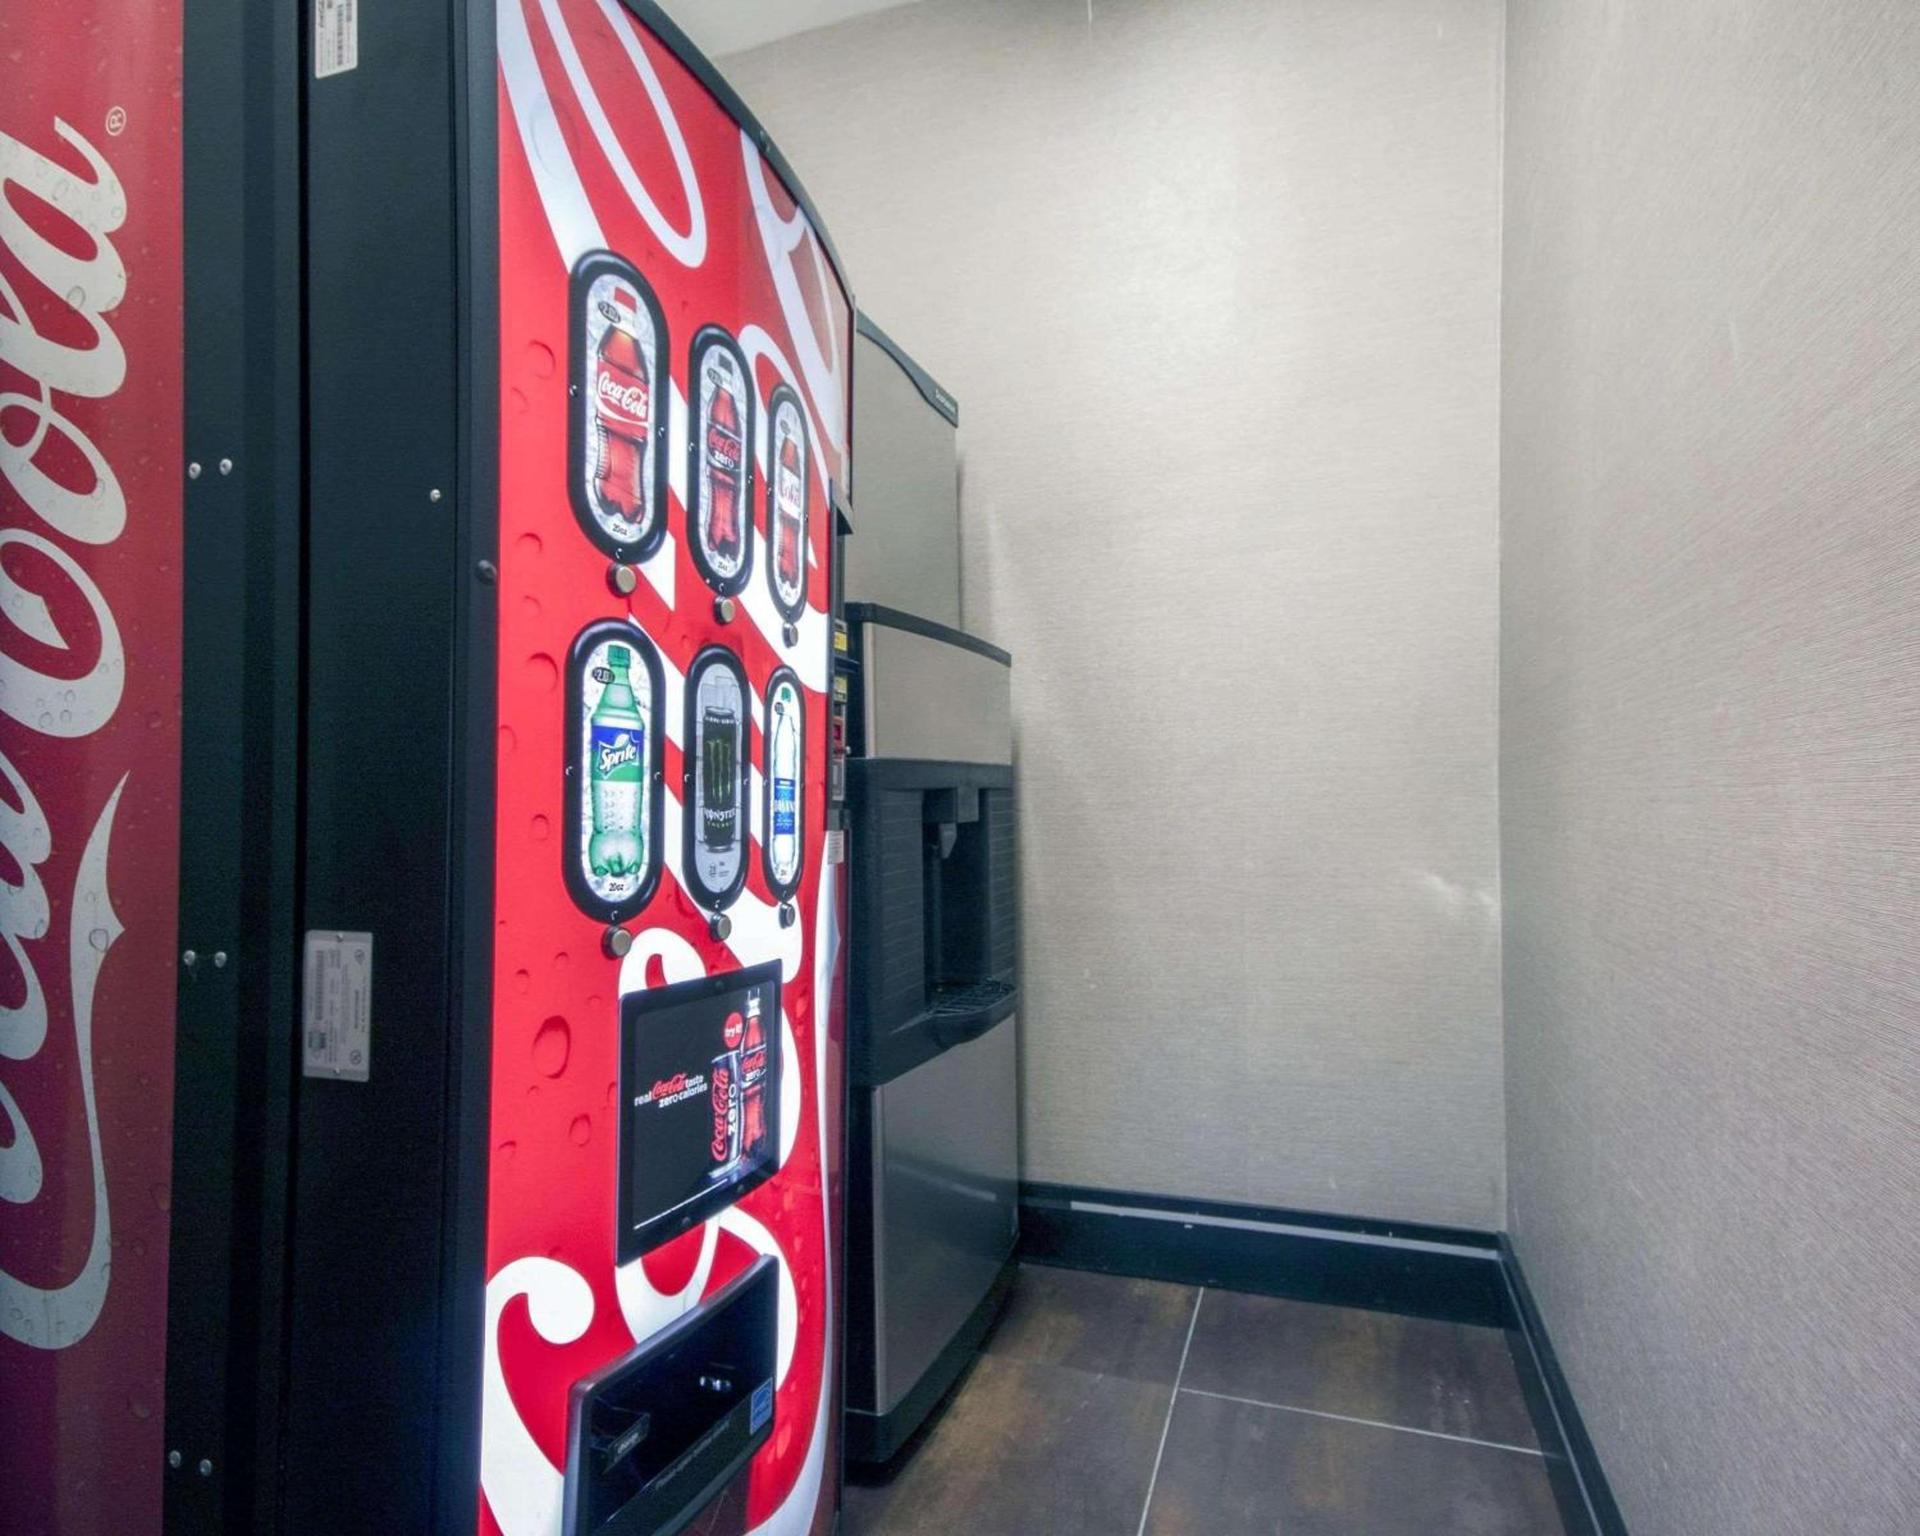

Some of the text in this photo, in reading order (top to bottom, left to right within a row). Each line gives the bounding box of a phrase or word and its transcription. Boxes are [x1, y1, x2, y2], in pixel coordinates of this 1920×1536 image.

[600, 746, 638, 772] Sprite
[634, 1090, 652, 1107] real
[727, 1083, 737, 1136] zero
